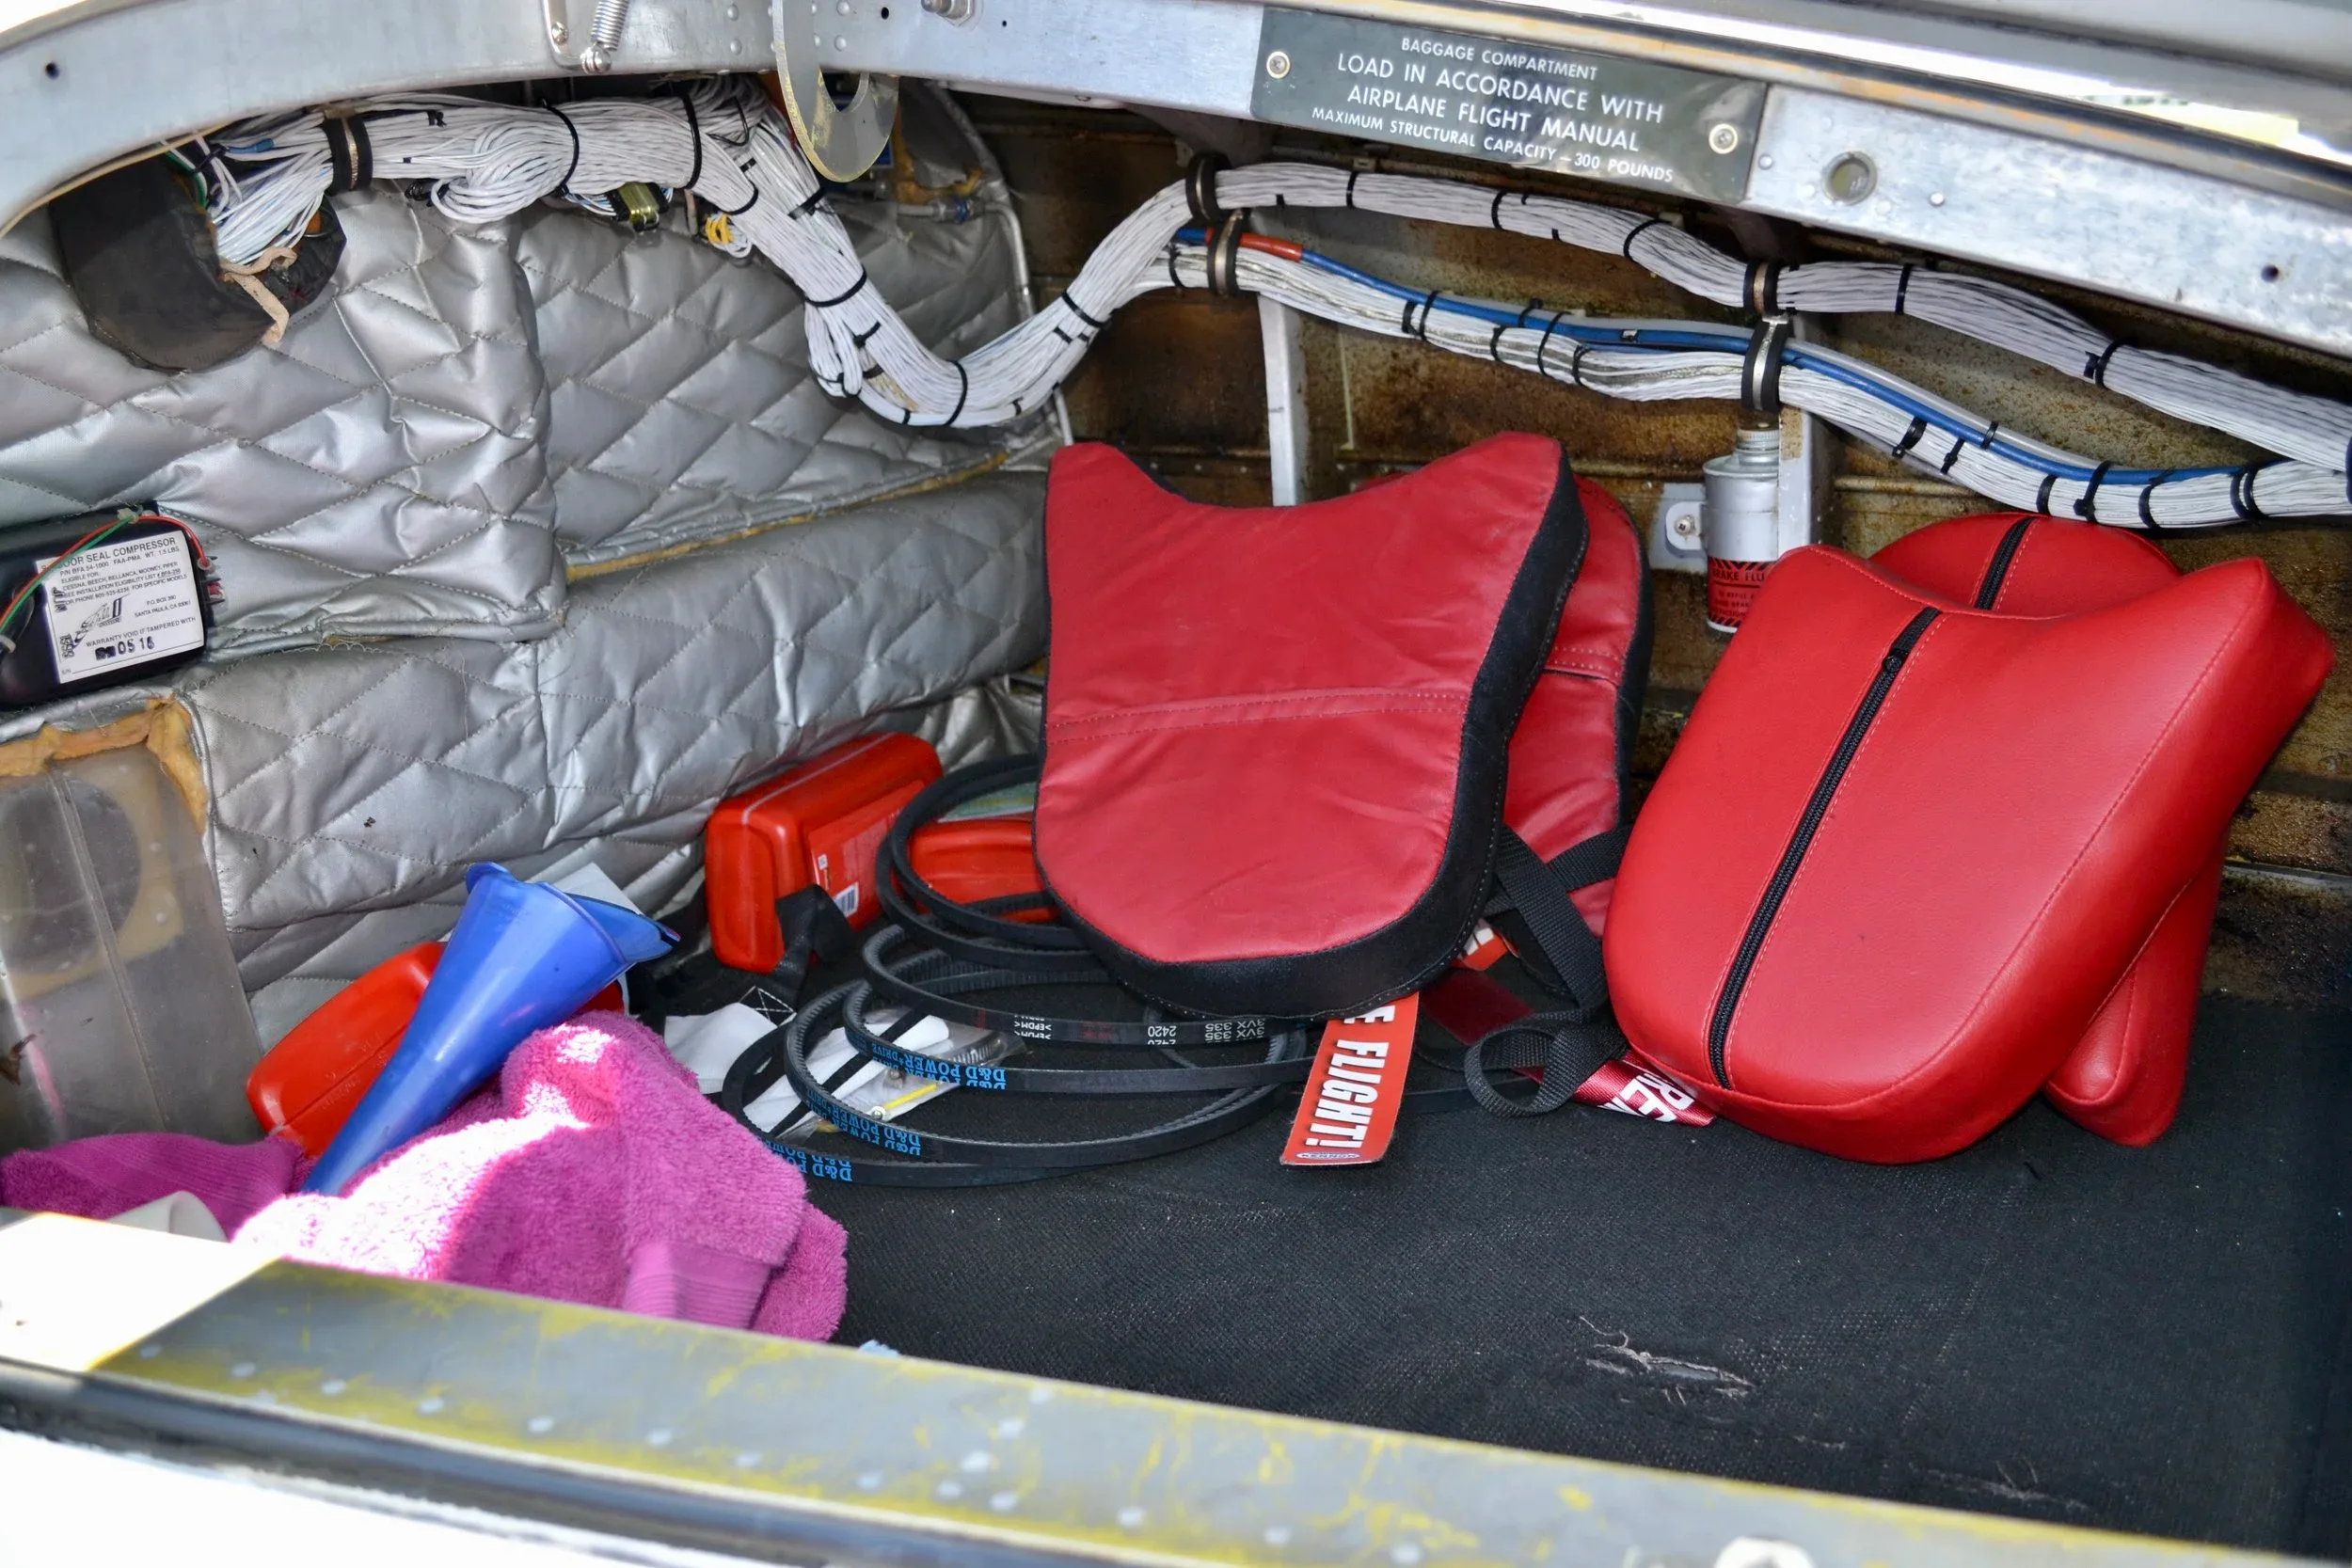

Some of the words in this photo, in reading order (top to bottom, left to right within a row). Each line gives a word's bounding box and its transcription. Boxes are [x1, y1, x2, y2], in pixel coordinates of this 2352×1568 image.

[1402, 38, 1475, 61] BAGGAGE
[1482, 49, 1597, 81] COMPARTMENT
[1338, 53, 1393, 78] LOAD
[1404, 63, 1425, 84] IN
[1436, 69, 1588, 111] ACCORDANCE
[1600, 94, 1663, 123] WITH
[1347, 85, 1447, 118] AIRPLANE
[1458, 103, 1532, 133] FLIGHT
[1540, 116, 1640, 151] MANUAL
[1312, 107, 1384, 131] MAXIMUM
[1390, 119, 1475, 147] STRUCTURAL
[1484, 136, 1557, 160] CAPACITY
[1574, 152, 1599, 169] 300
[1607, 158, 1675, 182] POUNDS
[59, 556, 85, 568] OOR
[86, 550, 111, 563] SEAL
[113, 537, 176, 557] COMPRESSOR
[61, 574, 87, 584] ELIGIBLE
[76, 583, 114, 595] INSTALLATION
[86, 633, 122, 647] WARRANTY
[122, 629, 139, 639] VOID
[146, 620, 181, 633] TAMPERED
[181, 616, 197, 625] WITH
[1147, 1025, 1177, 1037] 2420
[1205, 1022, 1232, 1032] 335
[1205, 1030, 1232, 1041] 335
[904, 1053, 961, 1078] POWER
[965, 1065, 1007, 1083] D&D
[1305, 1038, 1390, 1148] FLIGHT!
[831, 1105, 881, 1135] POWER
[883, 1127, 922, 1148] D&D
[812, 1163, 853, 1182] D&D
